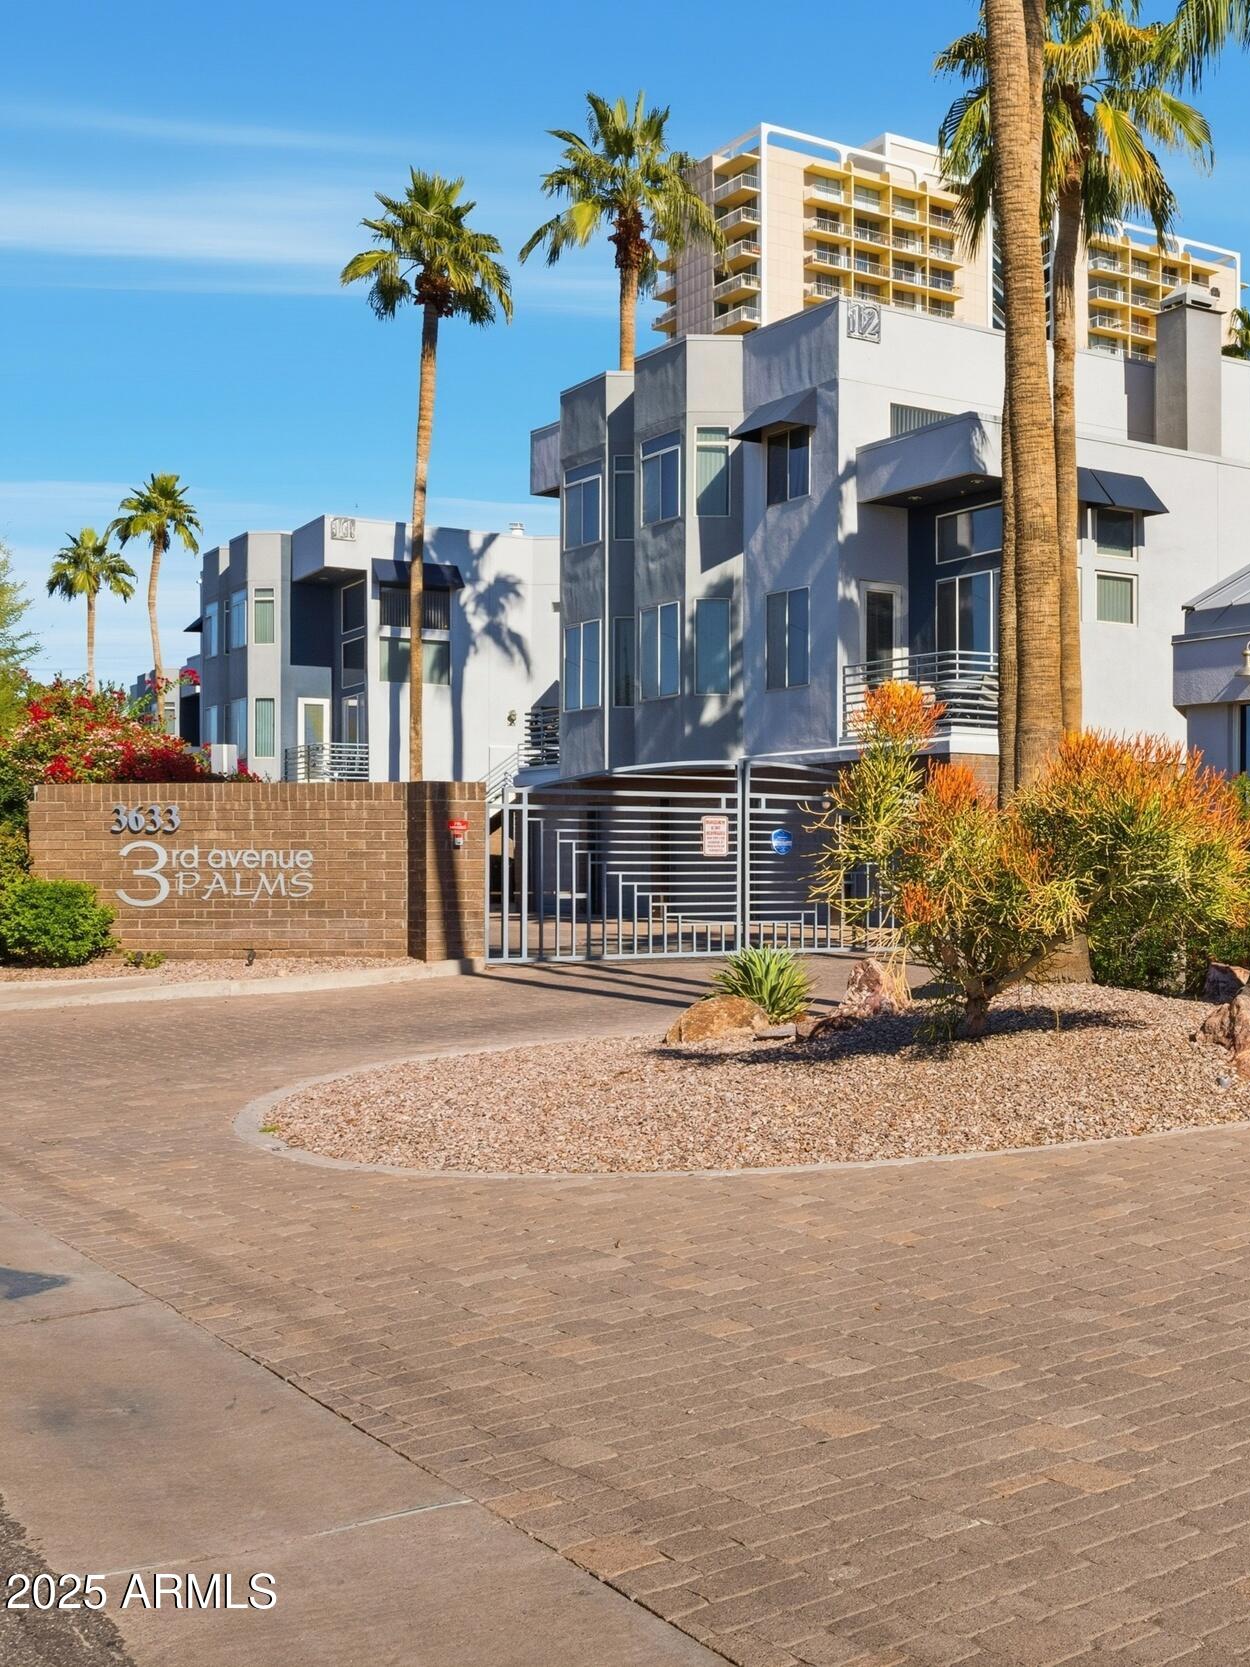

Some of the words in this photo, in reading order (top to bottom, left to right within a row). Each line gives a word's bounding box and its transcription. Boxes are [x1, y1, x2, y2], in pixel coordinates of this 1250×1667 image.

[848, 303, 880, 338] 12
[111, 804, 181, 834] 3633
[207, 849, 314, 869] avenue
[175, 871, 314, 903] PALMS
